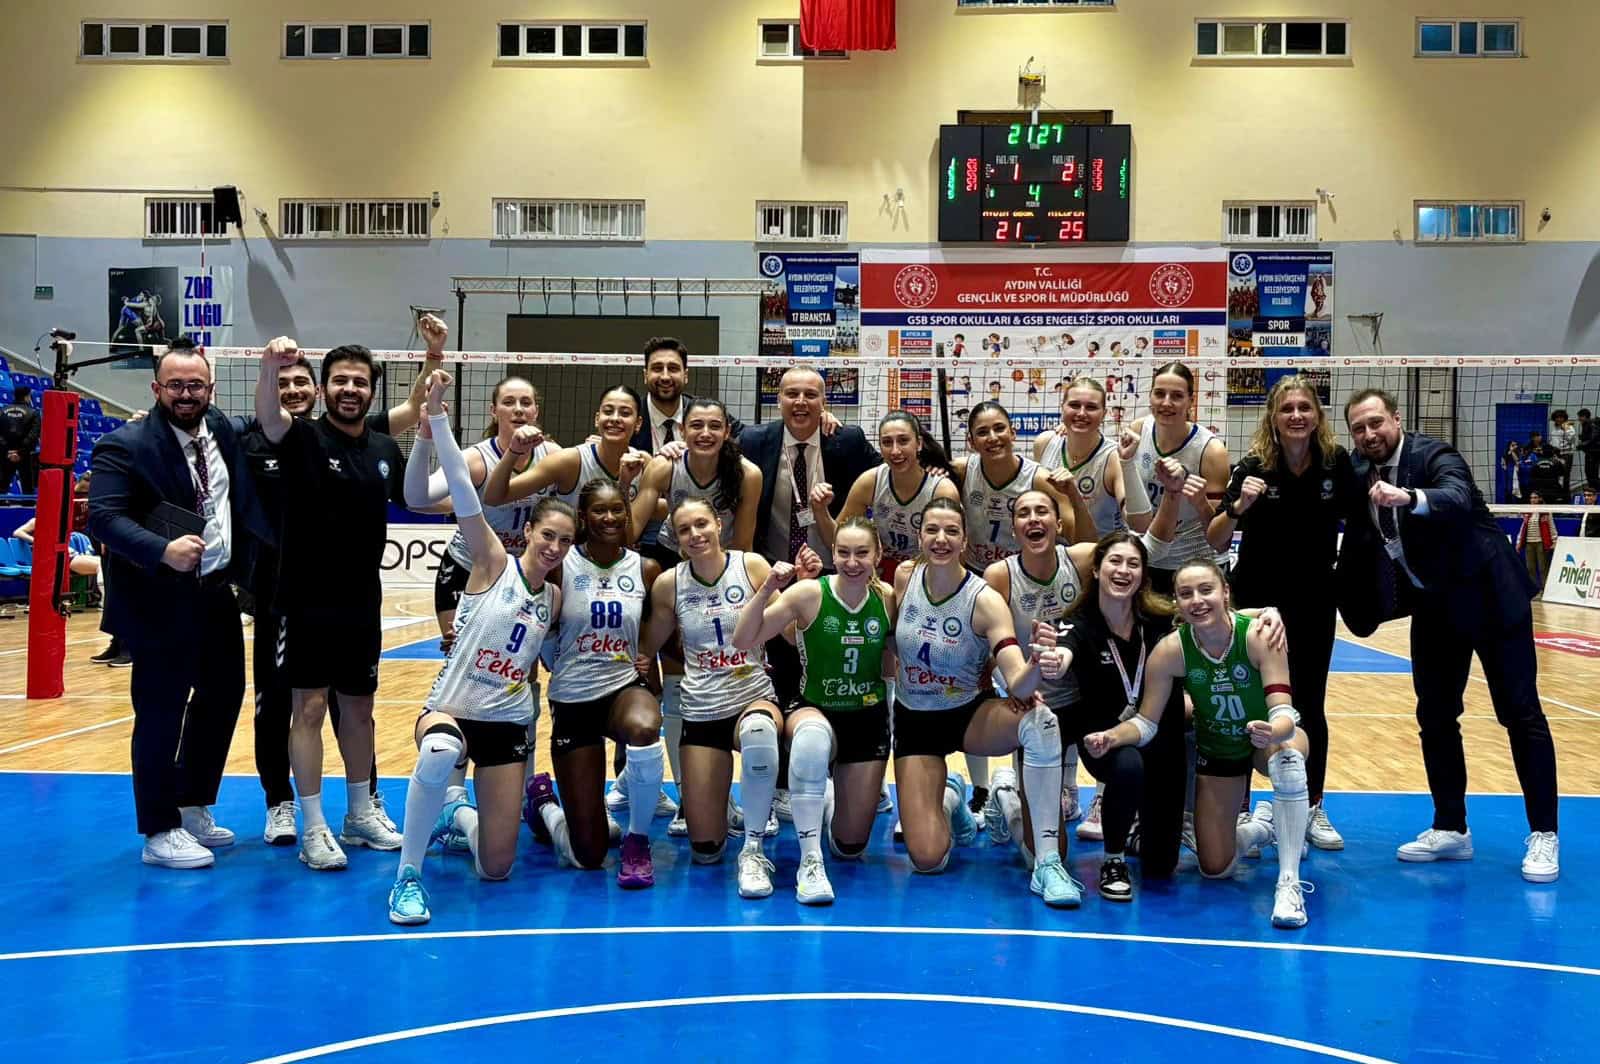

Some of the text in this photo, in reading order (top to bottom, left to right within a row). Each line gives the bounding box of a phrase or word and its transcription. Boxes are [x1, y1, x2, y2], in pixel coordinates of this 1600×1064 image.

[1062, 163, 1074, 181] 2
[1029, 184, 1040, 201] 4
[996, 221, 1021, 239] 21
[1060, 221, 1084, 239] 25
[1004, 279, 1082, 290] AYDIN VALİLİĞİ
[957, 292, 1001, 305] GENÇLİK
[1004, 294, 1017, 303] VE
[1019, 293, 1045, 303] SPOR
[1060, 290, 1129, 303] MÜDÜRLÜĞÜ
[800, 312, 831, 323] BRANŞTA
[907, 313, 1179, 325] GSB SPOR OKULLARI & GSB ENGELSİZ SPOR OKULLARI
[1268, 320, 1290, 330] SPOR
[1260, 335, 1298, 345] OKULLARI
[989, 520, 1001, 543] 7
[591, 600, 623, 629] 88
[506, 622, 527, 653] 9
[712, 617, 724, 646] 1
[843, 647, 860, 674] 3
[917, 642, 931, 668] 4
[1210, 695, 1247, 721] 20
